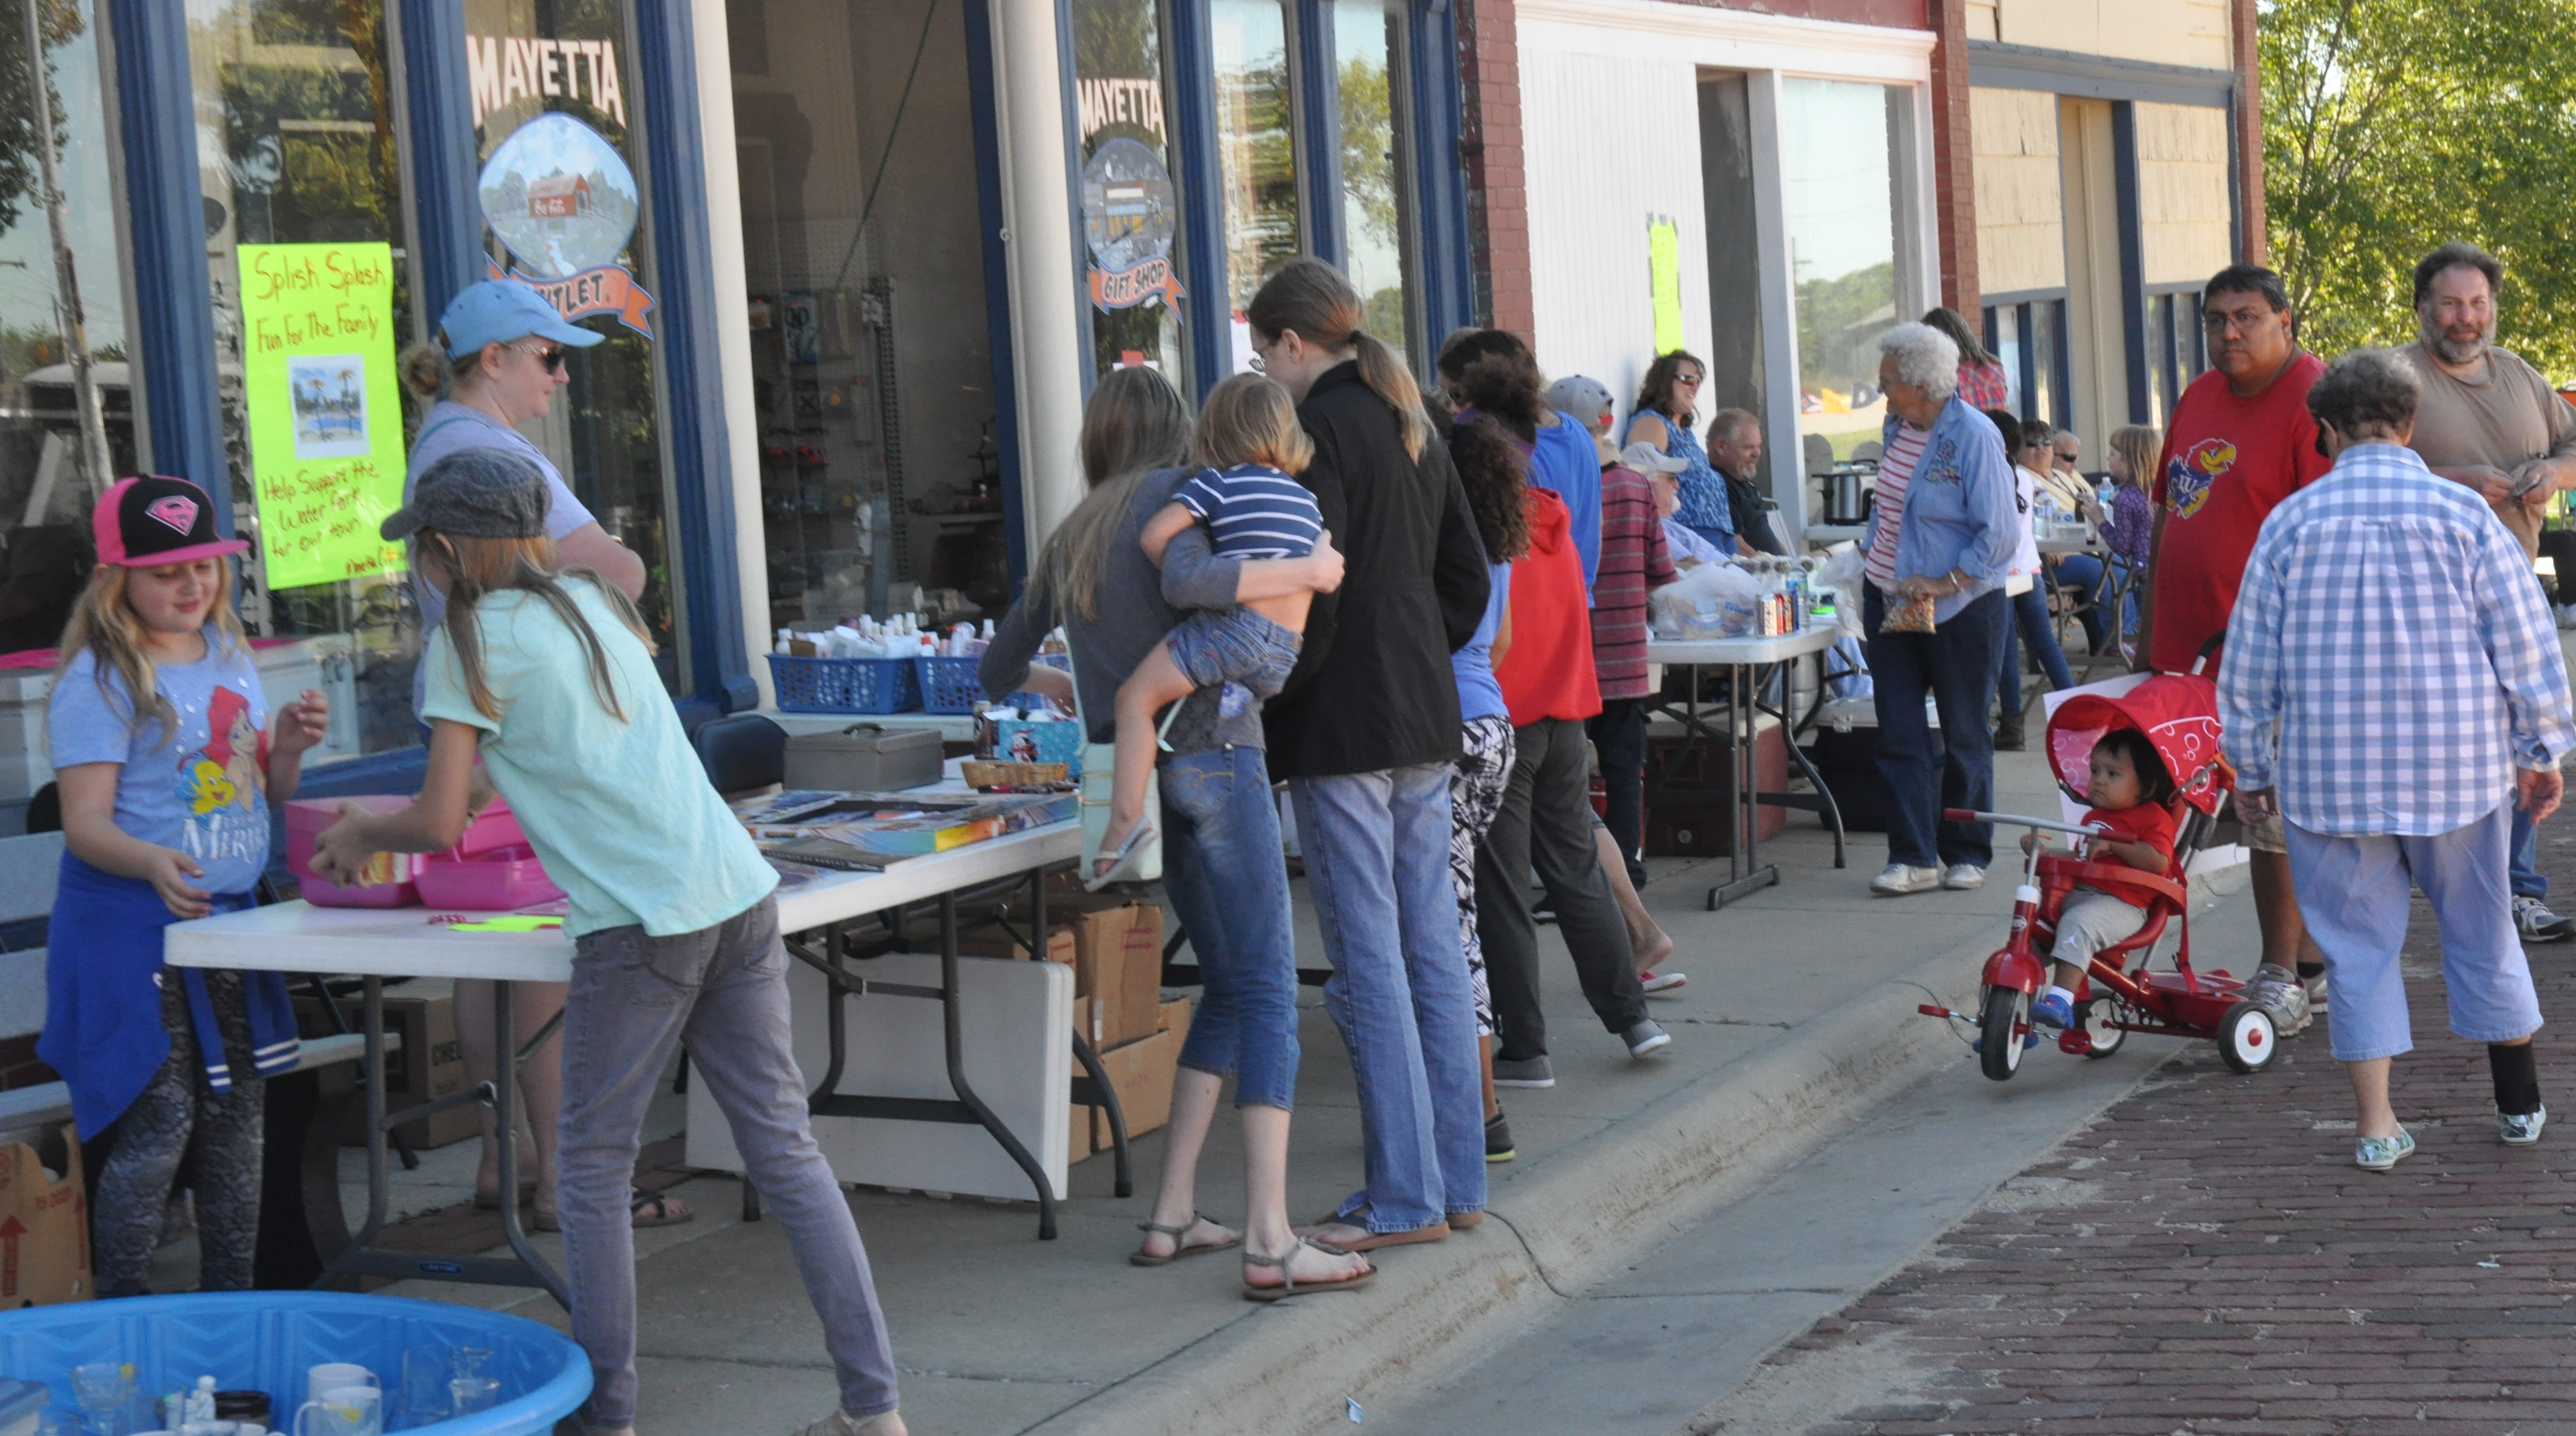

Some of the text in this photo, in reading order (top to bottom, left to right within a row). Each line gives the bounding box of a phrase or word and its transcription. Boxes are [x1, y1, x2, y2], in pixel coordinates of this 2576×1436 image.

[466, 34, 626, 131] MAYETTA
[1076, 77, 1168, 147] MAYETTA
[254, 250, 386, 304] Splish Splash
[1105, 261, 1165, 301] GIFT SHOP
[256, 317, 282, 353] Fun
[262, 475, 296, 504] Help
